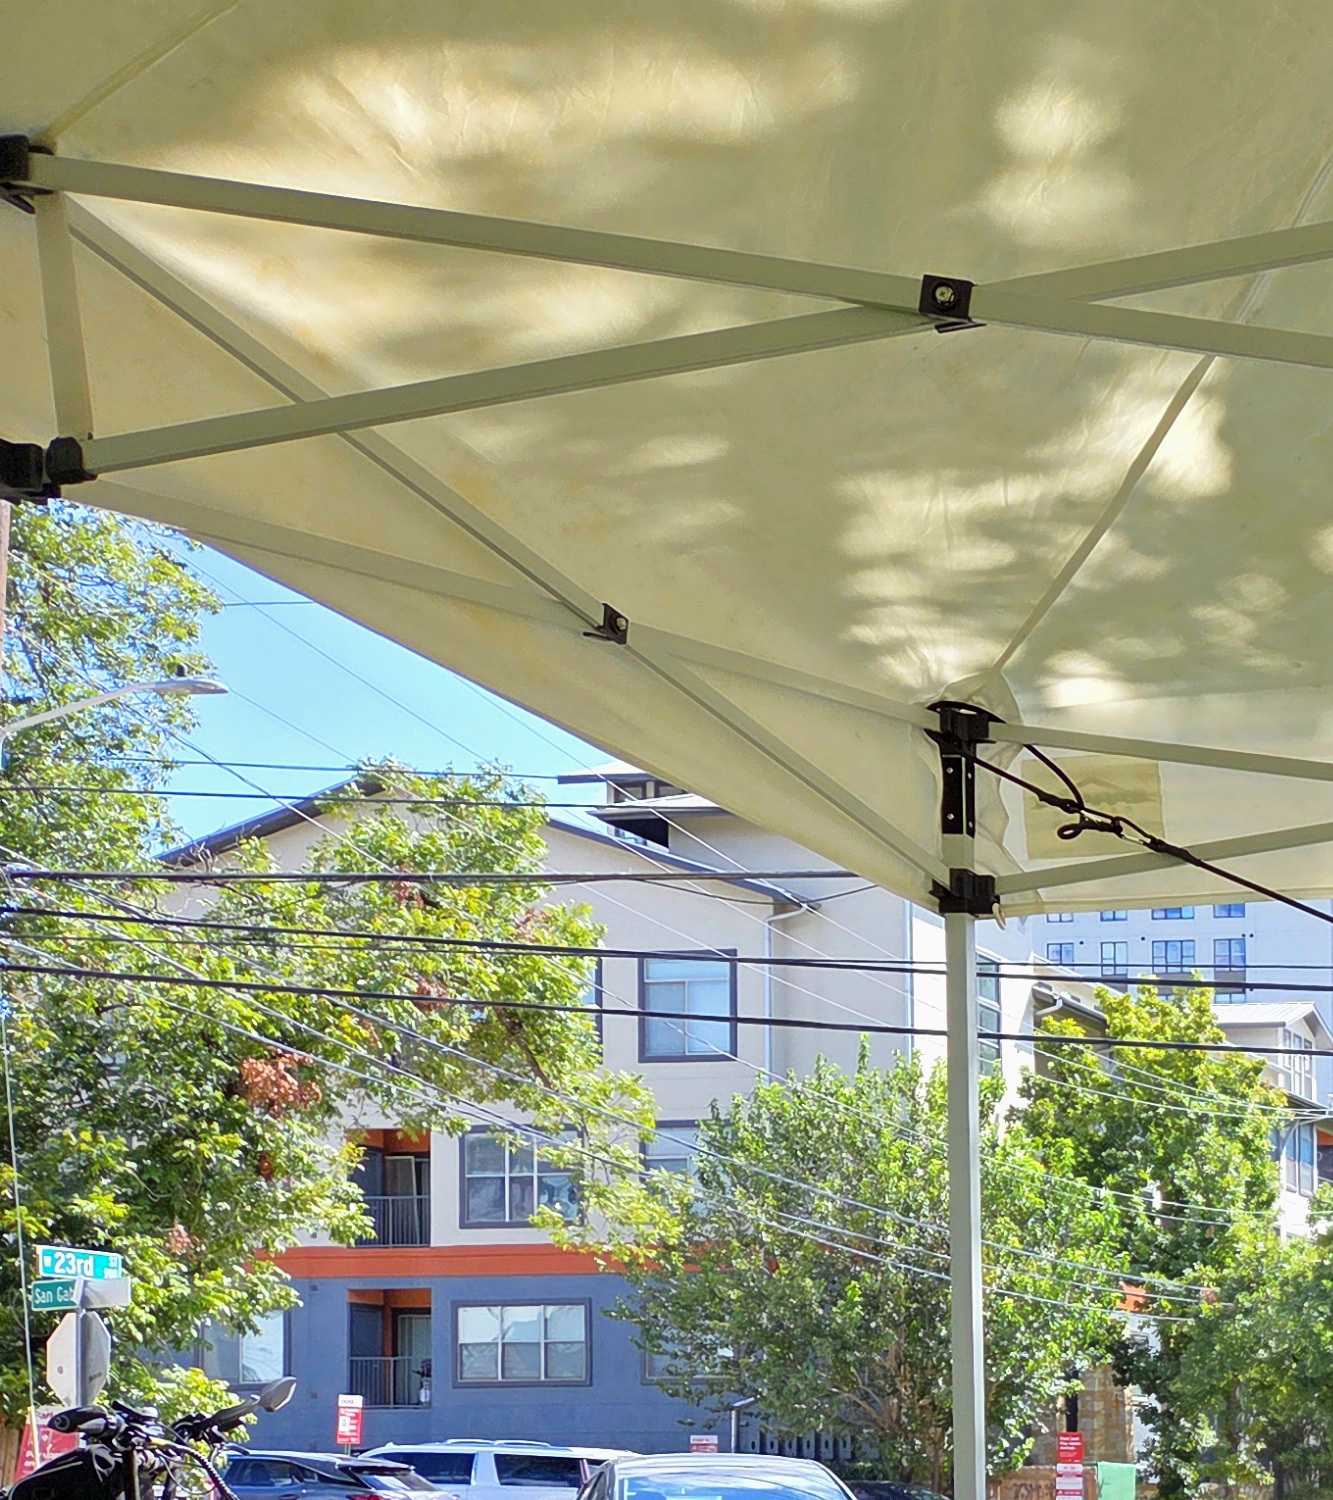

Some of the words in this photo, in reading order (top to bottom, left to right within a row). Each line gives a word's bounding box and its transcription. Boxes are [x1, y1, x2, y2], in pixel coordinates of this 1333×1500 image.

[54, 1252, 94, 1277] 23rd
[35, 1289, 53, 1304] San
[56, 1286, 75, 1302] Ga
